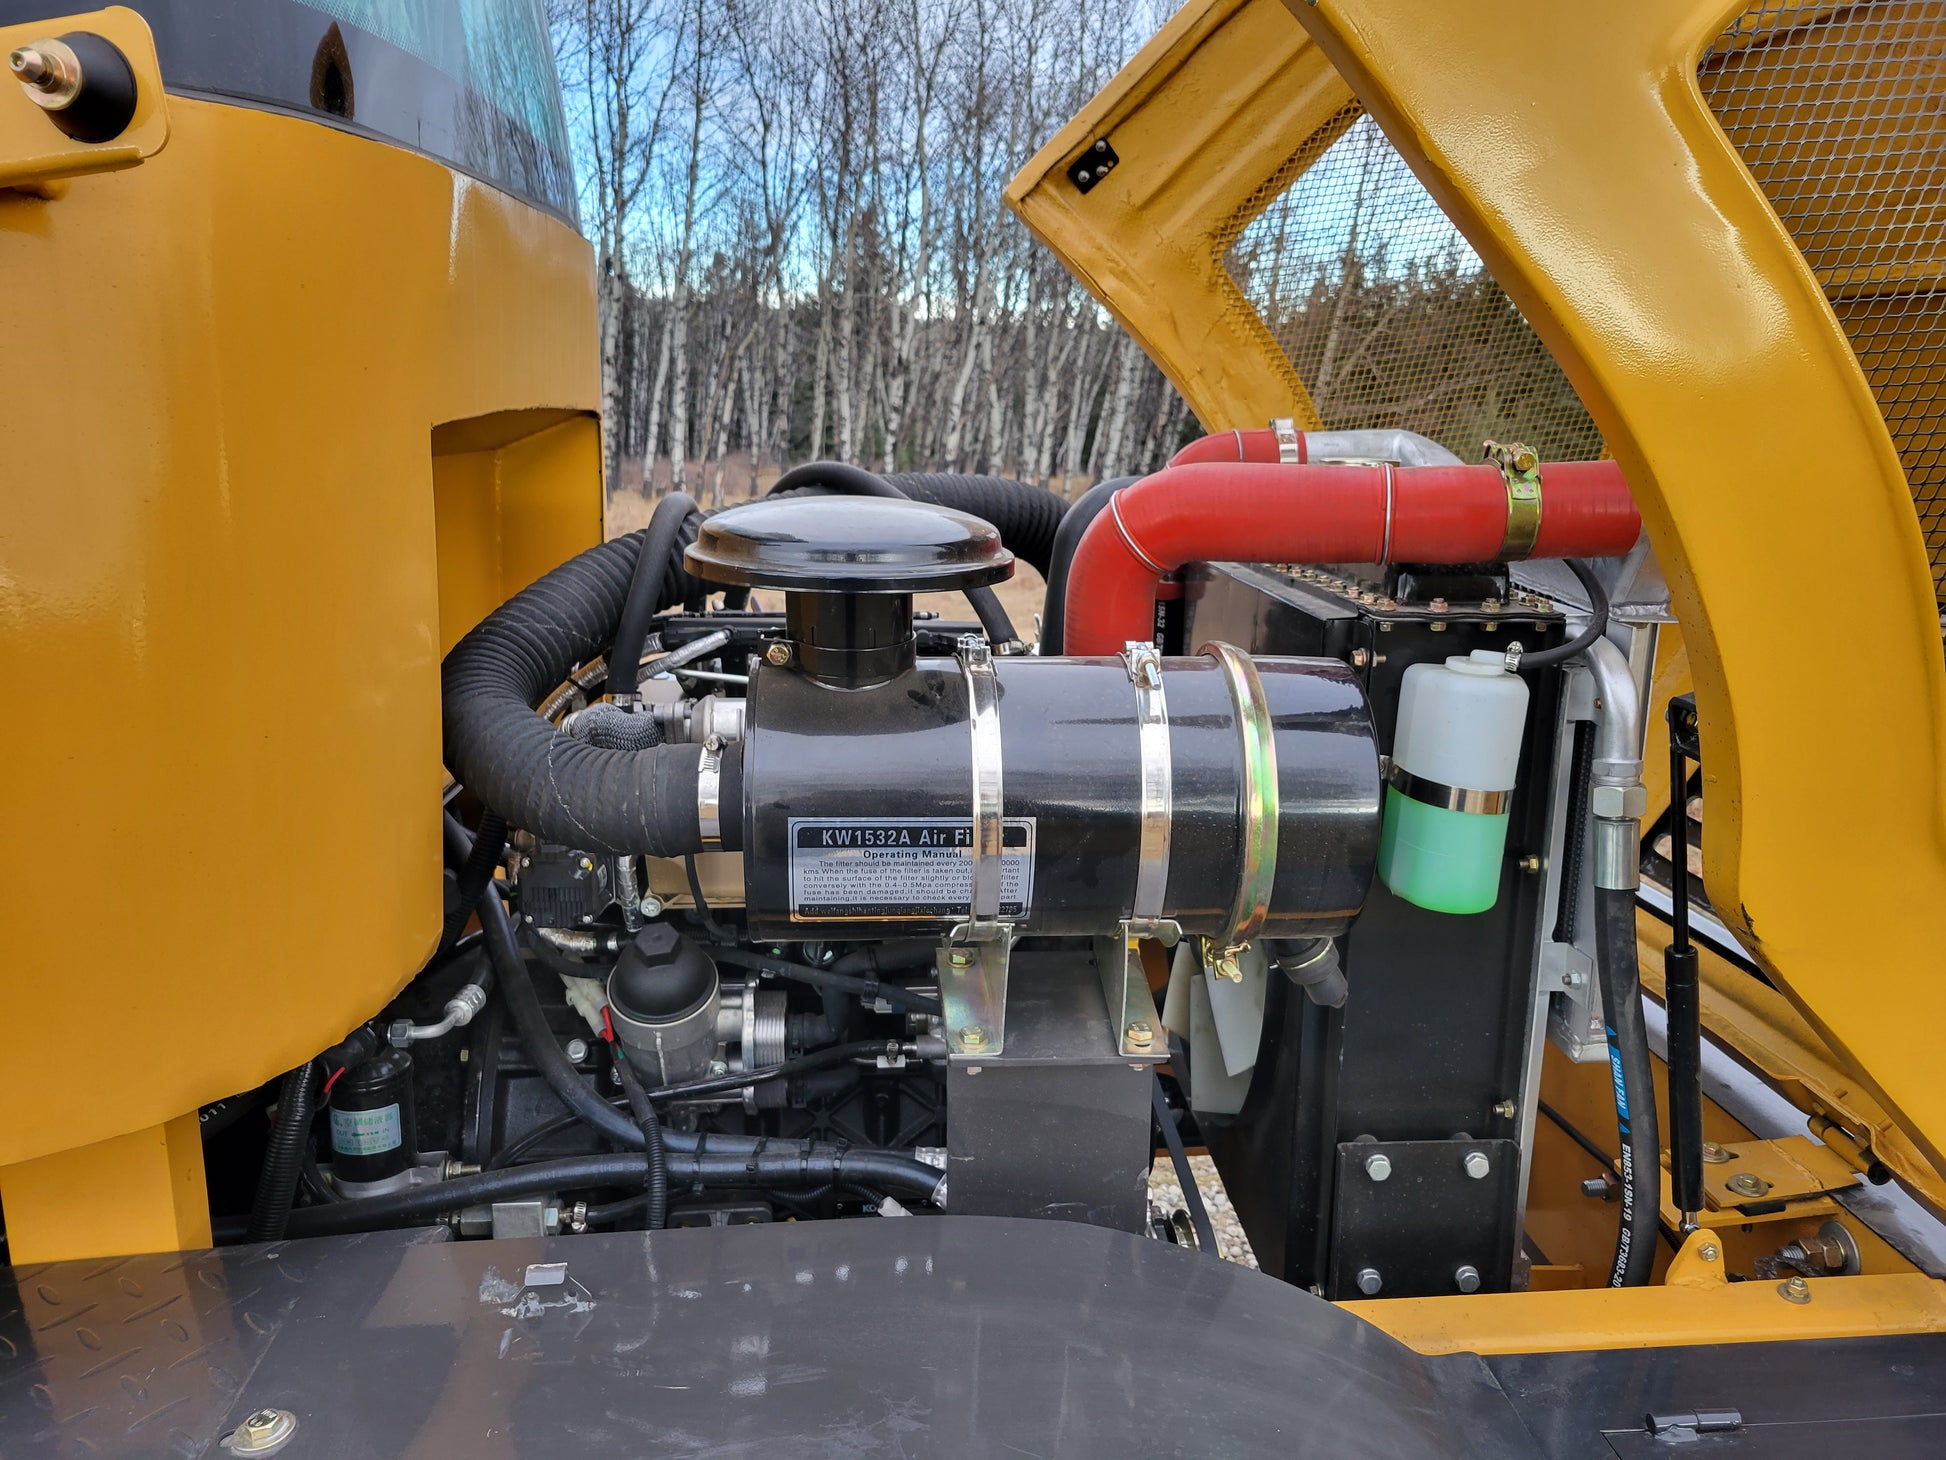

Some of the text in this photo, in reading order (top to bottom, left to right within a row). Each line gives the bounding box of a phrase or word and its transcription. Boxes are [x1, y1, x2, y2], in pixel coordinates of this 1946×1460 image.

[822, 830, 911, 845] KW1532A
[919, 830, 946, 845] Air
[863, 850, 962, 860] Operating Manual
[1610, 1055, 1626, 1110] SHAN FAN
[862, 1204, 877, 1213] KO
[1612, 1143, 1633, 1288] EN853-1SN-19 GB/T3683-20
